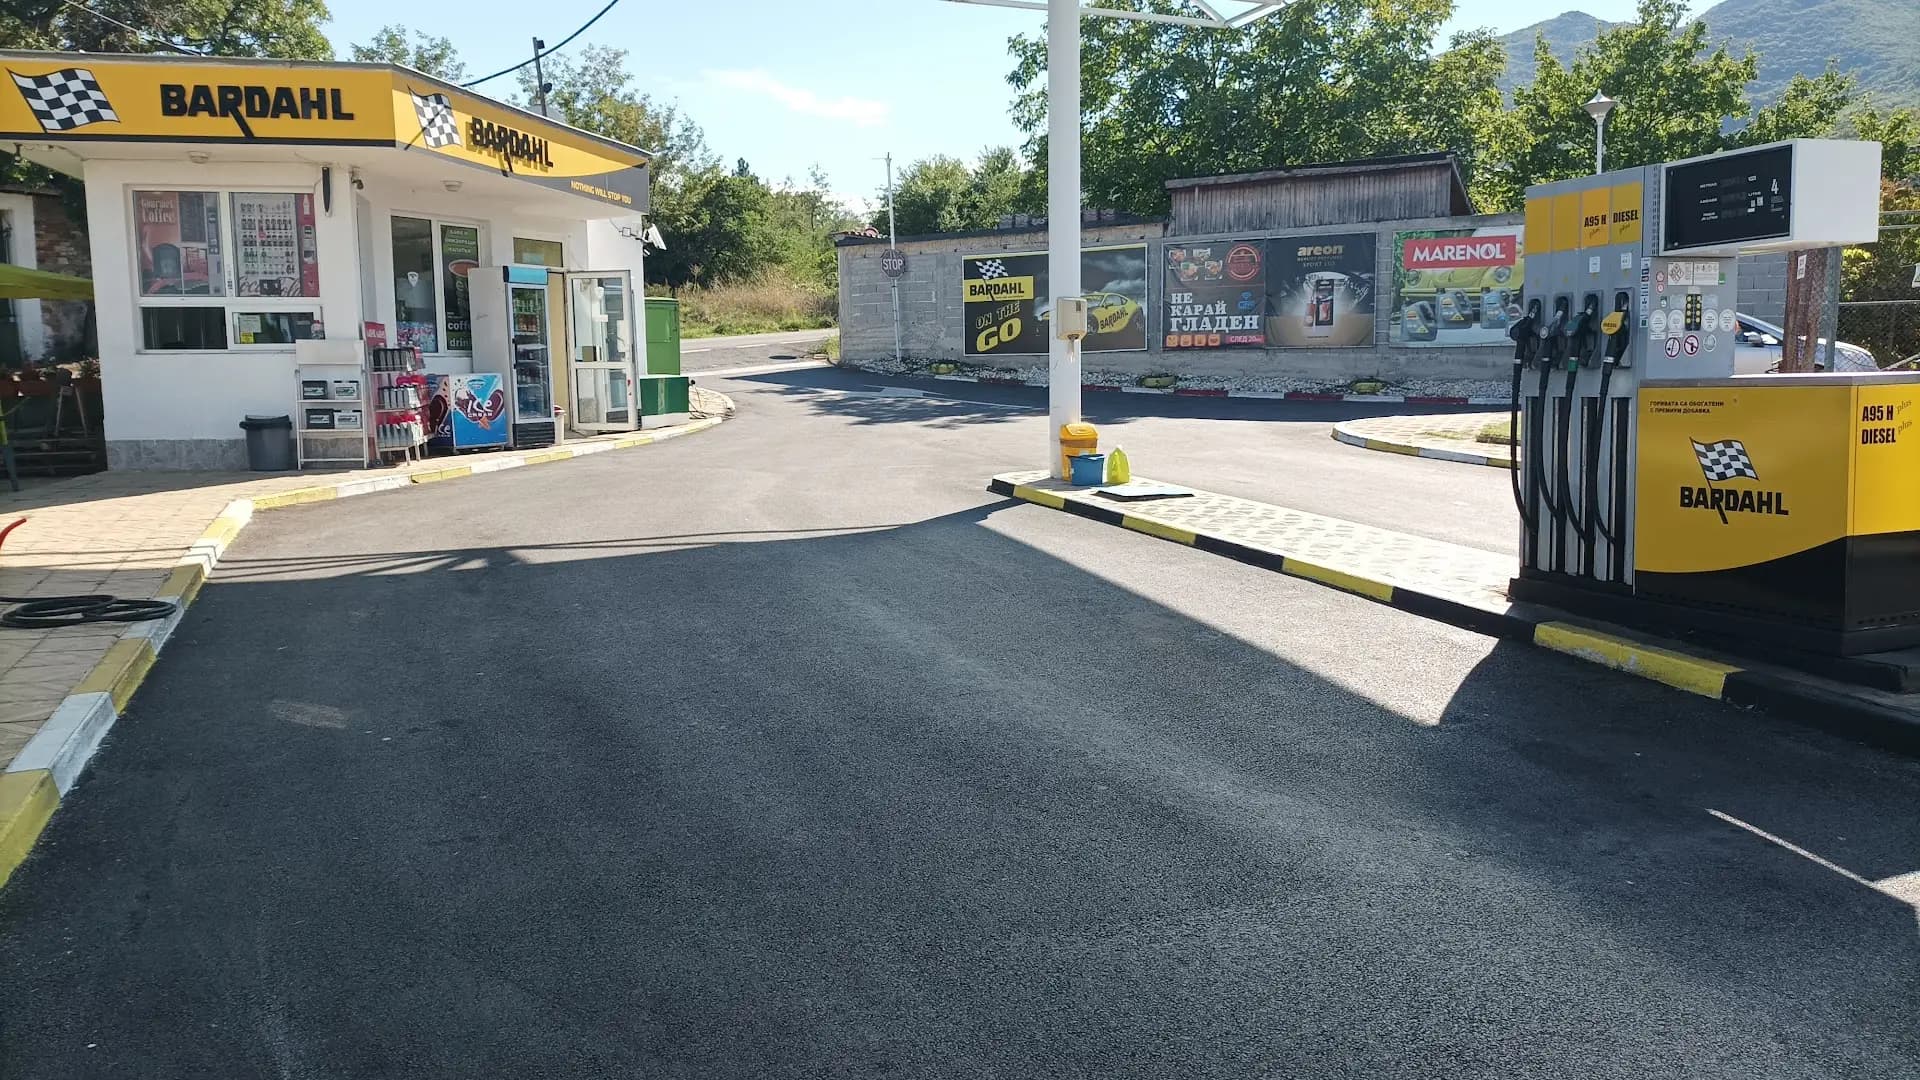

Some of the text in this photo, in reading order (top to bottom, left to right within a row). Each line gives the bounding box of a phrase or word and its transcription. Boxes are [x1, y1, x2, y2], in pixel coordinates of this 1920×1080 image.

[160, 84, 354, 137] BARDAHL
[470, 116, 554, 174] BARDAHL
[571, 180, 632, 204] NOTHING WILL STOP YOU
[1770, 178, 1779, 194] 4
[142, 208, 176, 224] Coffee
[1584, 214, 1607, 228] A95 H
[1613, 209, 1639, 223] DIESEL
[1297, 244, 1344, 257] areon
[1413, 243, 1506, 262] MARENOL
[881, 257, 903, 271] STOP
[969, 281, 1025, 300] BARDAHL
[1171, 292, 1193, 304] НЕ
[976, 303, 1020, 329] ON THE
[1171, 300, 1227, 316] КАРАЙ
[447, 320, 471, 331] coff
[1099, 308, 1129, 330] BARDAHL
[1171, 314, 1260, 333] ГЛАДЕН
[449, 338, 471, 347] drin
[976, 317, 1022, 352] GO
[1230, 335, 1248, 343] СЛЕД
[1862, 398, 1912, 422] A95 H plus
[1861, 419, 1913, 444] DIESEL plus
[1680, 486, 1789, 525] BARDAHL
